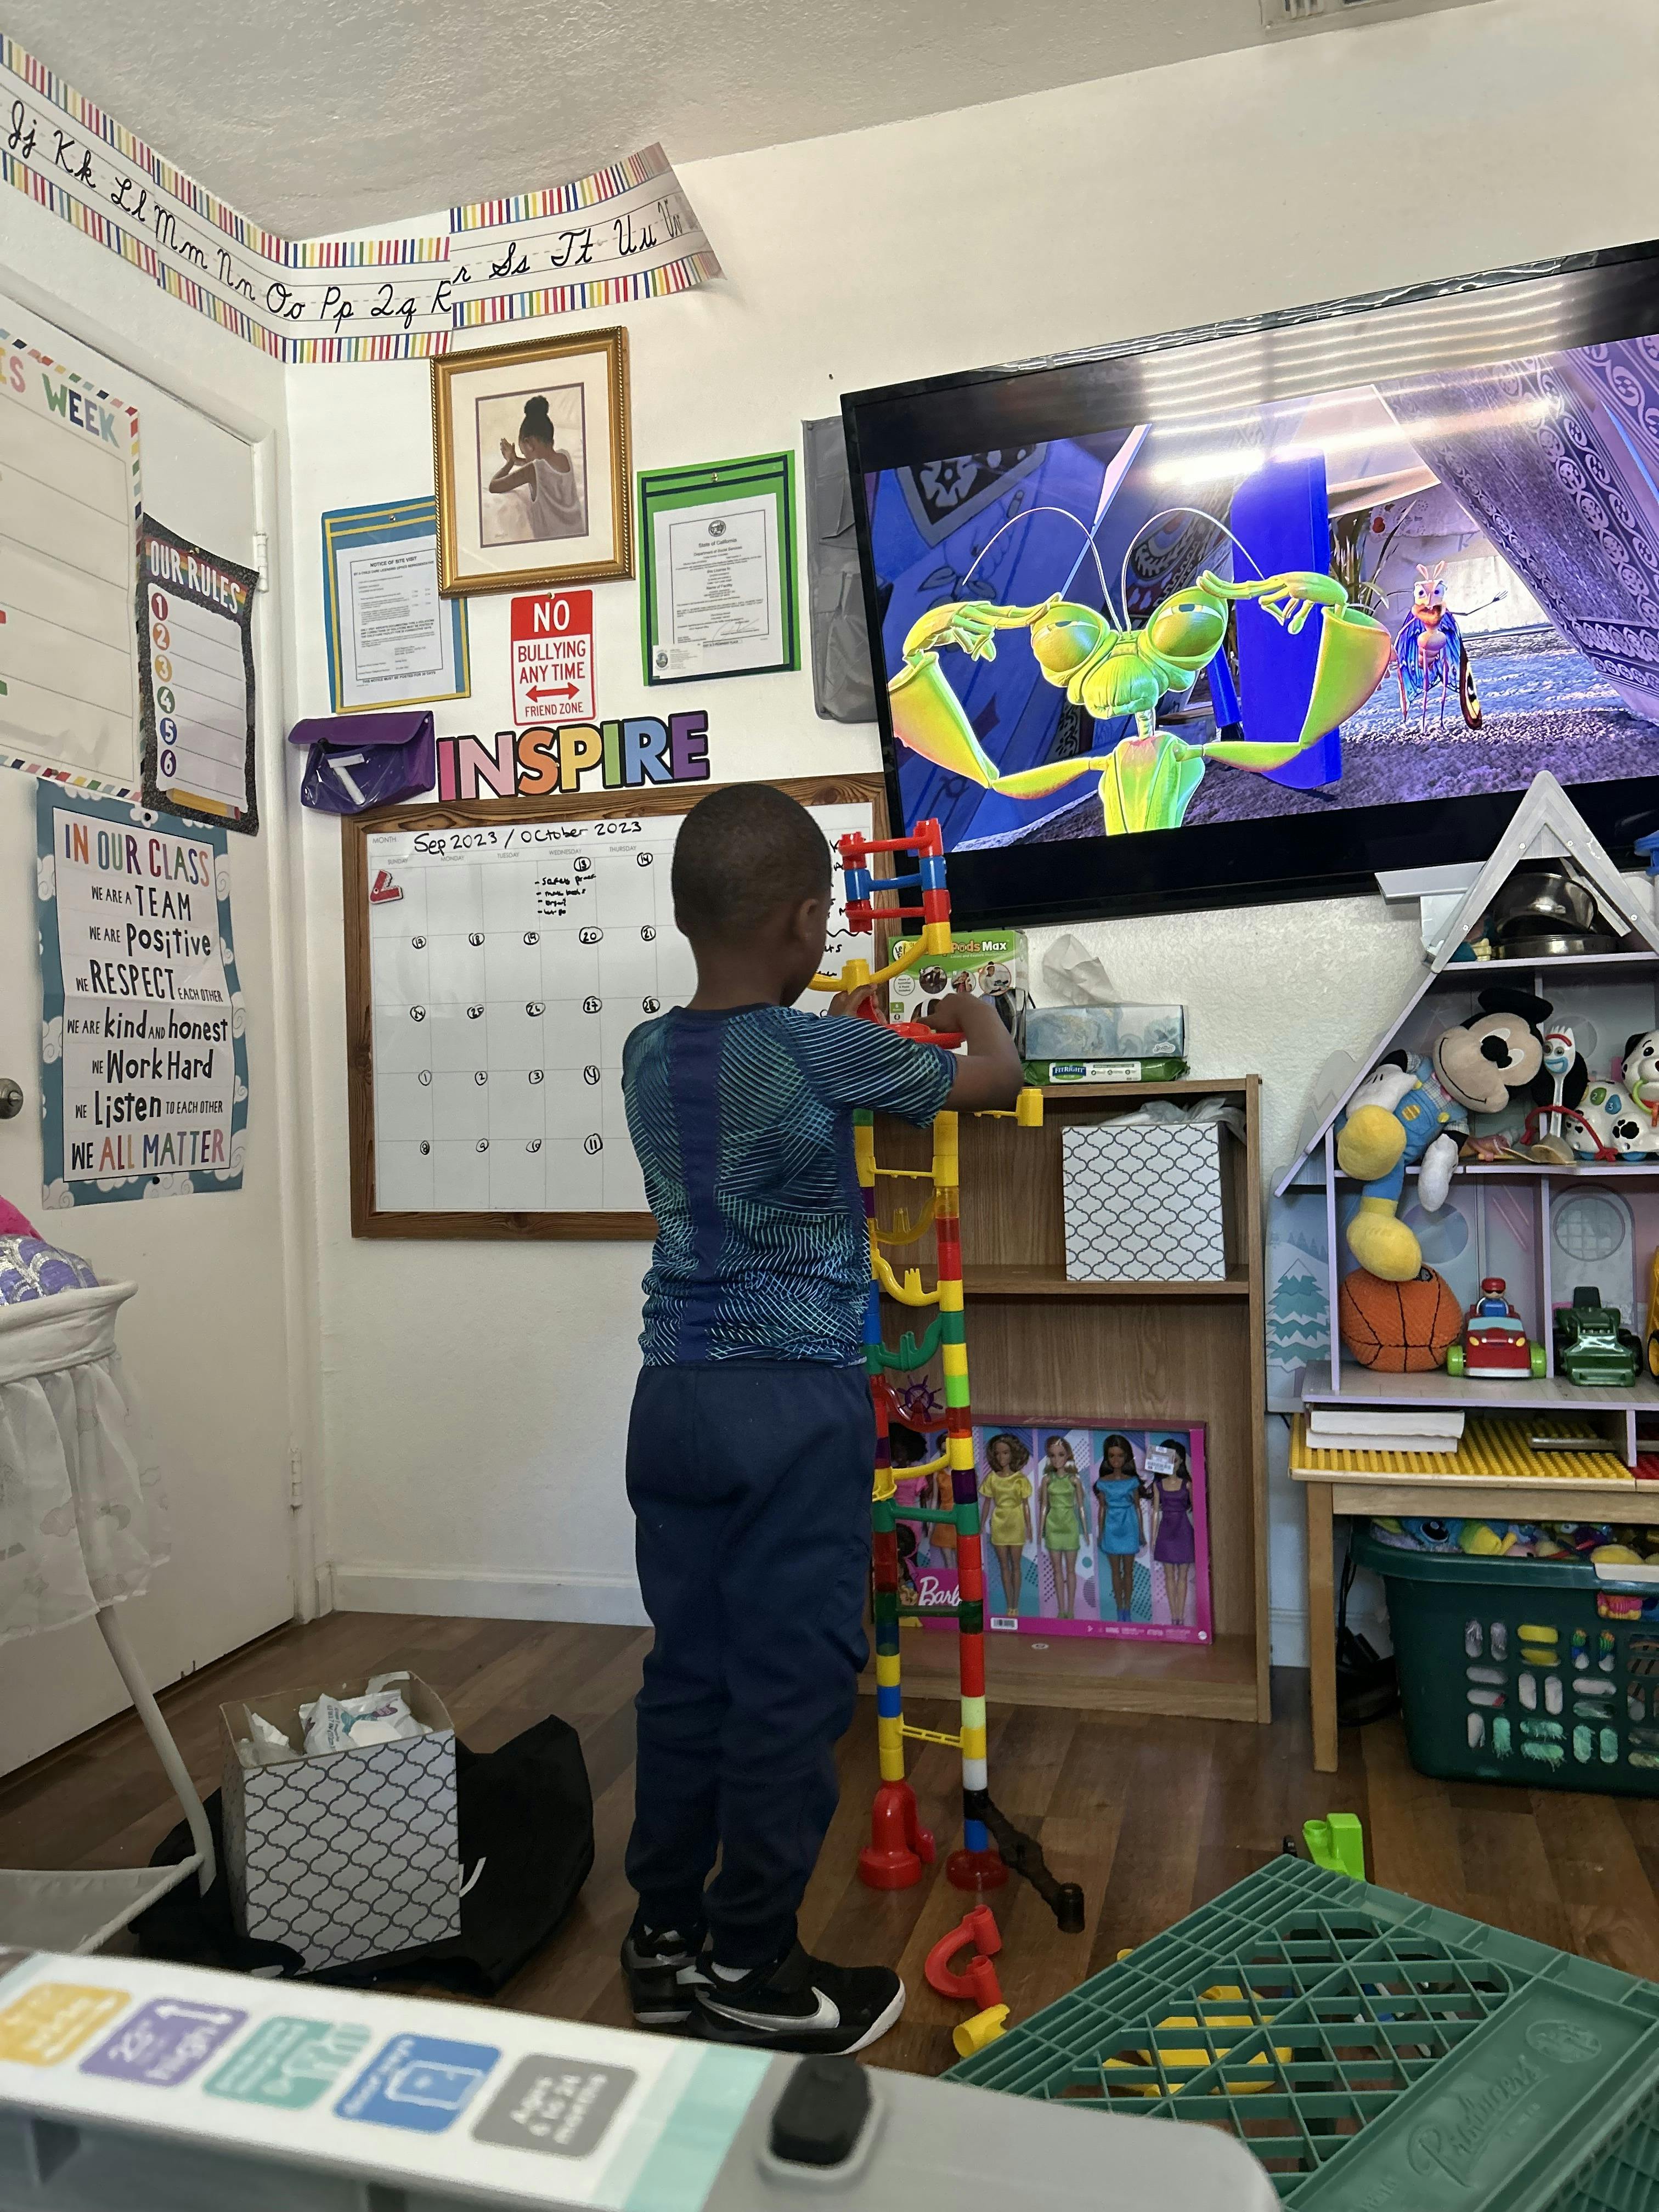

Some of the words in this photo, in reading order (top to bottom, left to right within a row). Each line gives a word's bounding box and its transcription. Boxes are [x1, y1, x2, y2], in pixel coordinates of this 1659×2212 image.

[53, 129, 97, 189] Kk
[110, 176, 146, 223] Ll
[154, 205, 208, 270] Mm
[217, 248, 256, 302] Nn
[266, 282, 306, 320] Oo
[320, 286, 354, 334] Pp
[489, 242, 531, 279] Ss
[550, 228, 592, 267] Tt
[613, 215, 657, 256] Uu
[42, 373, 120, 449] WEEK
[150, 540, 184, 585] OUR
[188, 555, 241, 614] RULES
[155, 596, 163, 618] 1
[533, 600, 571, 633] NO
[156, 624, 167, 648] 2
[518, 640, 586, 663] BULLYING
[159, 656, 170, 679] 3
[520, 664, 548, 684] ANY
[551, 662, 585, 681] TIME
[160, 689, 172, 712] 4
[525, 704, 557, 718] FRIEND
[559, 702, 584, 715] ZONE
[165, 720, 174, 742] 5
[165, 752, 173, 774] 6
[436, 710, 710, 802] INSPIRE
[372, 836, 397, 844] MONTH
[414, 832, 445, 856] Sep
[450, 831, 498, 849] 2023
[521, 826, 589, 844] October
[594, 821, 642, 837] 2023
[549, 848, 582, 856] WEDNESDAY
[609, 845, 637, 853] THURSDAY
[65, 823, 89, 865] IN
[98, 830, 142, 875] OUR
[149, 838, 210, 887] CLASS
[91, 885, 103, 900] WE
[106, 888, 123, 904] ARE
[126, 891, 132, 905] A
[135, 884, 191, 922] TEAM
[89, 926, 101, 941] WE
[104, 928, 121, 943] ARE
[981, 940, 1007, 952] Max
[76, 977, 89, 993] WE
[89, 959, 175, 1001] RESPECT
[177, 988, 199, 1001] EACH
[201, 989, 223, 1003] OTHER
[67, 1019, 80, 1034] WE
[82, 1020, 100, 1035] ARE
[104, 1006, 148, 1039] kind
[148, 1025, 165, 1040] AND
[168, 1008, 228, 1042] honest
[92, 1059, 104, 1075] WE
[107, 1047, 163, 1084] Work
[167, 1048, 214, 1080] Hard
[75, 1104, 87, 1119] WE
[94, 1090, 161, 1128] Listen
[166, 1101, 175, 1115] TO
[177, 1101, 199, 1114] EACH
[200, 1100, 223, 1114] OTHER
[1592, 1092, 1598, 1101] 2
[1608, 1102, 1614, 1111] 3
[71, 1142, 94, 1171] WE
[99, 1133, 135, 1172] ALL
[143, 1128, 225, 1169] MATTER
[918, 1576, 962, 1607] Barb
